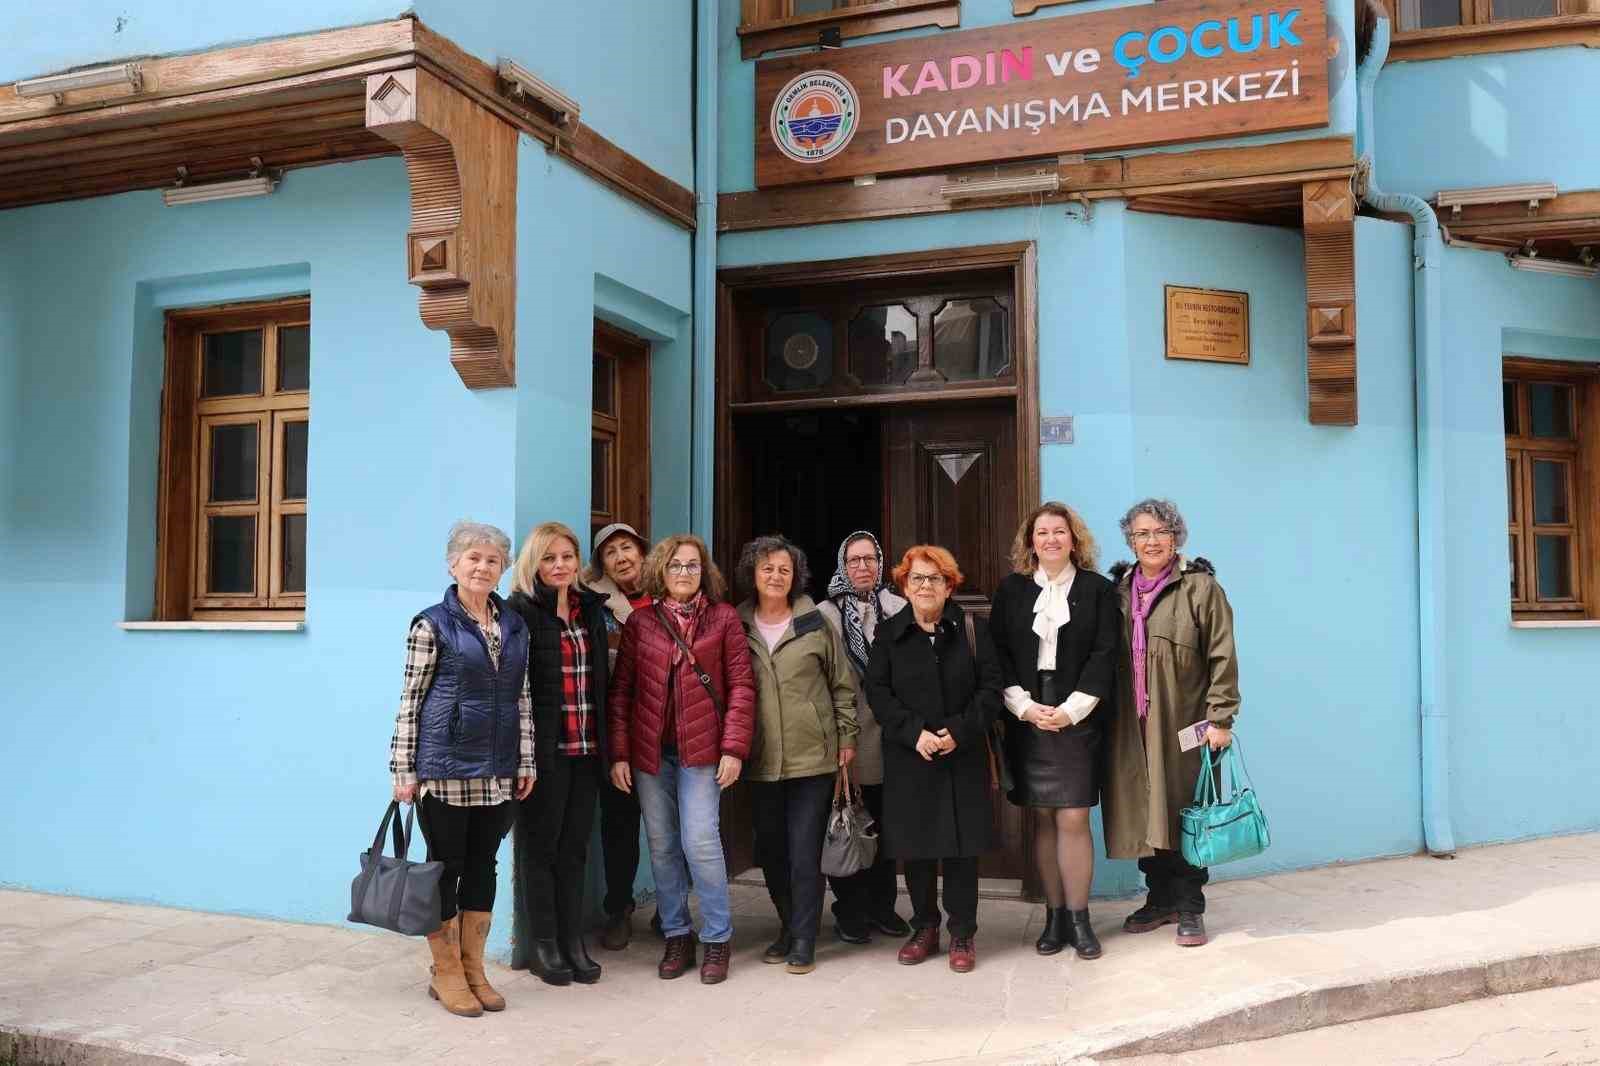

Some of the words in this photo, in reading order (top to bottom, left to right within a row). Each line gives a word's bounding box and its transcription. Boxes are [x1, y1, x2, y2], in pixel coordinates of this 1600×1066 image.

[882, 47, 1033, 99] KADIN
[1044, 47, 1101, 77] ve
[1112, 8, 1304, 80] ÇOCUK
[885, 91, 1111, 145] DAYANIŞMA
[1121, 59, 1300, 116] MERKEZİ
